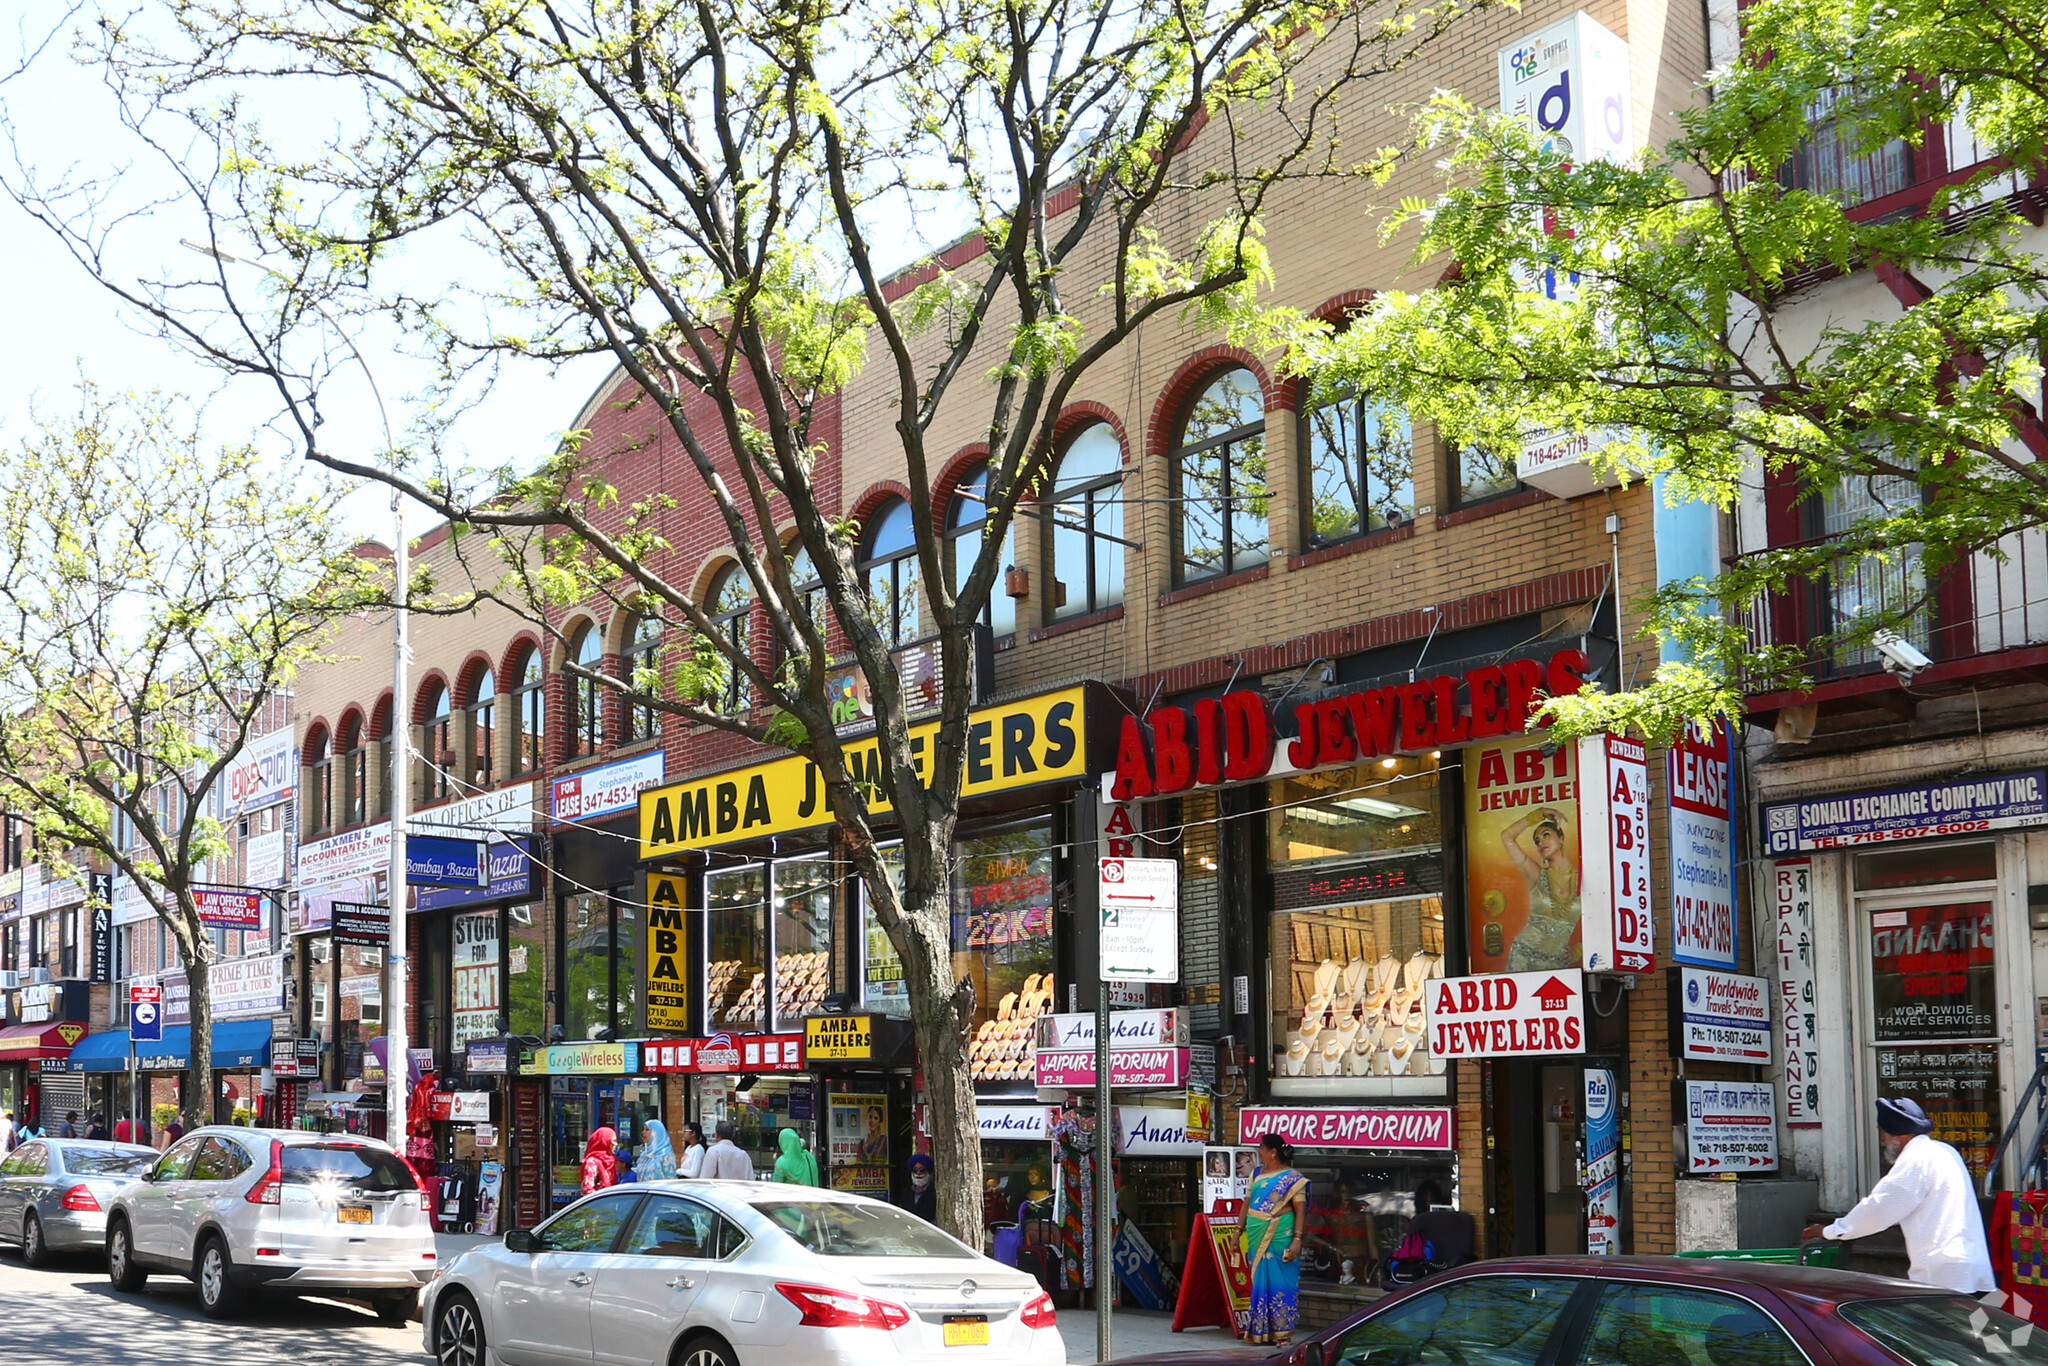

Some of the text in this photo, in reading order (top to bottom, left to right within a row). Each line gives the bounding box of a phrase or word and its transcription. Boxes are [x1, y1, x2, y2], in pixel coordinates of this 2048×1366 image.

[1111, 648, 1592, 799] ABID JEWELERS
[1609, 738, 1646, 761] JEWELERS
[599, 774, 632, 790] Stephanie
[1672, 748, 1729, 811] LEASE
[561, 781, 575, 796] FOR
[1632, 790, 1646, 803] 718
[441, 796, 493, 826] OFFICES
[499, 789, 518, 811] OF
[556, 794, 580, 818] LEASE
[651, 774, 772, 847] AMBA
[1801, 776, 2042, 828] SONALI EXCHANGE COMPANY INC.
[1769, 806, 1796, 831] SE
[1803, 824, 1840, 839] সোনালী
[1874, 816, 1917, 832] লিমিটেড
[1921, 815, 1938, 826] এর
[1942, 810, 1971, 823] একটি
[319, 829, 372, 851] TAXMEN &
[1771, 831, 1796, 851] CI
[1811, 816, 2043, 849] TEL: 718-507-6002 37-17
[300, 841, 371, 866] ACCOUNTANTS,
[1612, 767, 1638, 943] ABID
[1691, 841, 1711, 859] Realty
[406, 858, 477, 881] Bombay Bazar
[1677, 857, 1728, 889] Stephanie An
[1126, 874, 1170, 883] Except Sunday
[202, 893, 248, 908] LAW OFFICES
[335, 903, 356, 913] TAXMEN
[222, 906, 246, 918] SINGH,
[1104, 908, 1118, 926] 2
[649, 879, 683, 980] AMBA
[1676, 895, 1731, 954] 347-453-1369
[1105, 944, 1154, 954] Except Sunday
[1126, 936, 1144, 945] 10pm
[472, 945, 487, 962] FOR
[212, 960, 273, 984] PRIME TIME
[867, 967, 903, 981] WE BUY
[214, 978, 272, 995] TRAVEL & TOURS
[455, 966, 500, 1009] RENT
[647, 980, 685, 994] JEWELERS
[868, 985, 882, 994] VISA
[1706, 975, 1759, 1002] Worldwide
[1777, 870, 1803, 1118] RUPALI EXCHANGE
[655, 997, 677, 1006] 37-13
[1123, 991, 1145, 1003] 2929
[1435, 977, 1518, 1015] ABID
[1544, 998, 1565, 1009] 37-13
[647, 1008, 668, 1018] (718)
[1706, 996, 1764, 1018] Travels Services
[1894, 1004, 1974, 1016] WORLDWIDE
[647, 1017, 685, 1028] 639-2300
[819, 1018, 858, 1033] AMBA
[1878, 1015, 1992, 1026] TRAVEL SERVICES
[807, 1032, 871, 1048] JEWELERS
[1432, 1016, 1581, 1054] JEWELERS
[1691, 1026, 1762, 1046] Ph: 718-507-2244
[697, 1049, 738, 1060] WIRELESS
[829, 1048, 848, 1057] 37-13
[1716, 1047, 1726, 1055] 2ND
[1881, 1052, 1895, 1064] SE
[1040, 1054, 1088, 1072] JAIPUR
[1882, 1064, 1895, 1076] CI
[1587, 1076, 1607, 1096] Ria
[1959, 1079, 1987, 1089] খোলা
[1691, 1103, 1702, 1118] CI
[1245, 1113, 1443, 1142] JAIPUR EMPORIUM
[1942, 1111, 1971, 1128] EXPRESS
[1697, 1143, 1769, 1153] Tel: 718-507-6002
[856, 1168, 885, 1178] AMBA
[851, 1178, 886, 1186] JEWELERS
[1207, 1178, 1230, 1187] SAIRA
[1588, 1179, 1617, 1200] EMPLOYMENT
[1588, 1231, 1606, 1242] 100%
